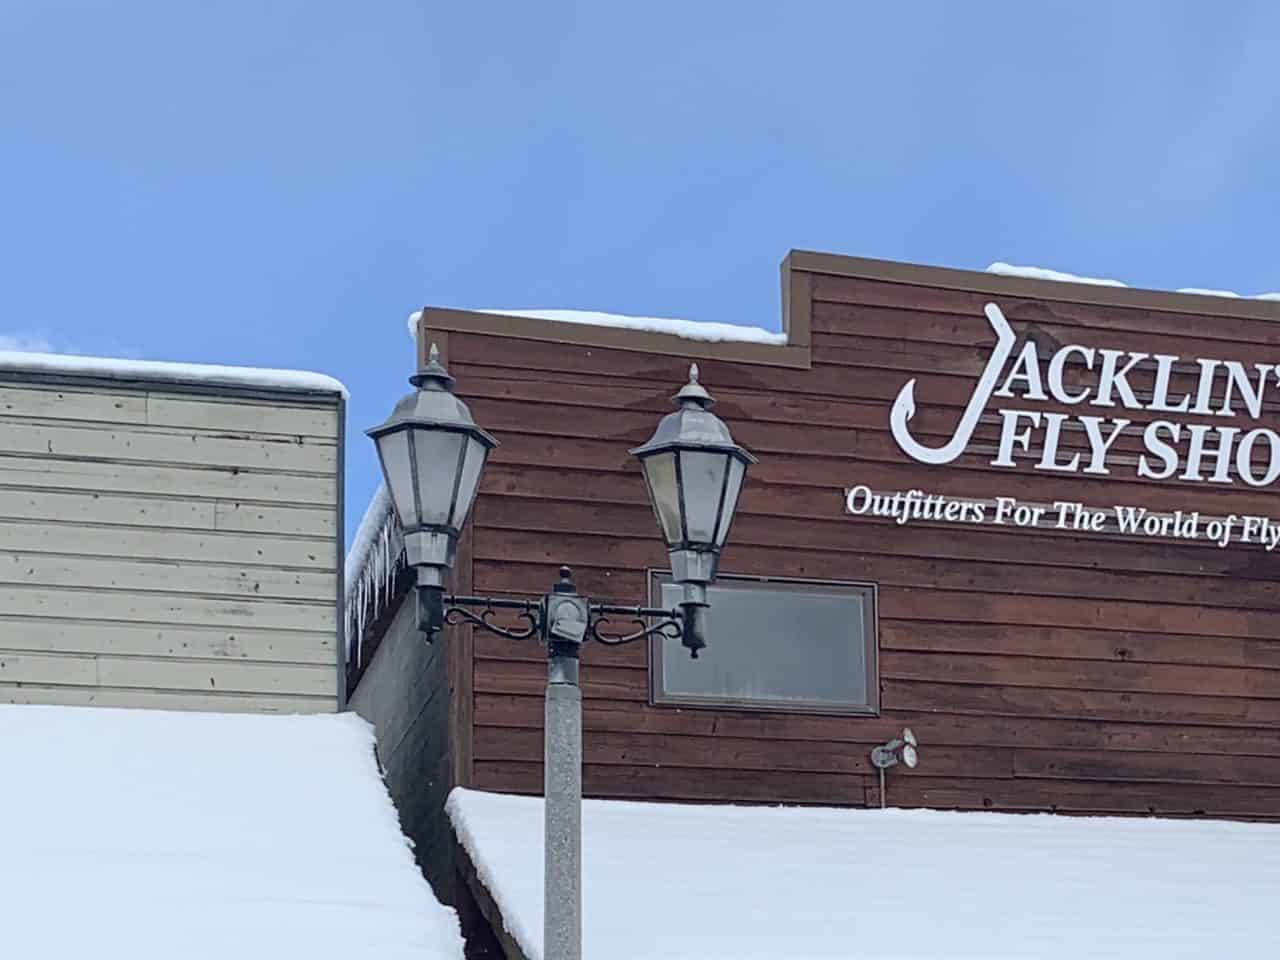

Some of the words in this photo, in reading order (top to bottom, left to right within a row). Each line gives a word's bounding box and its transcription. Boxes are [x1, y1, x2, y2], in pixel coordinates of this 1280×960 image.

[990, 409, 1131, 474] FLY
[847, 485, 985, 524] Outfitters
[993, 497, 1045, 526] For
[1053, 501, 1106, 531] The
[1114, 505, 1198, 538] World
[1206, 515, 1236, 547] of
